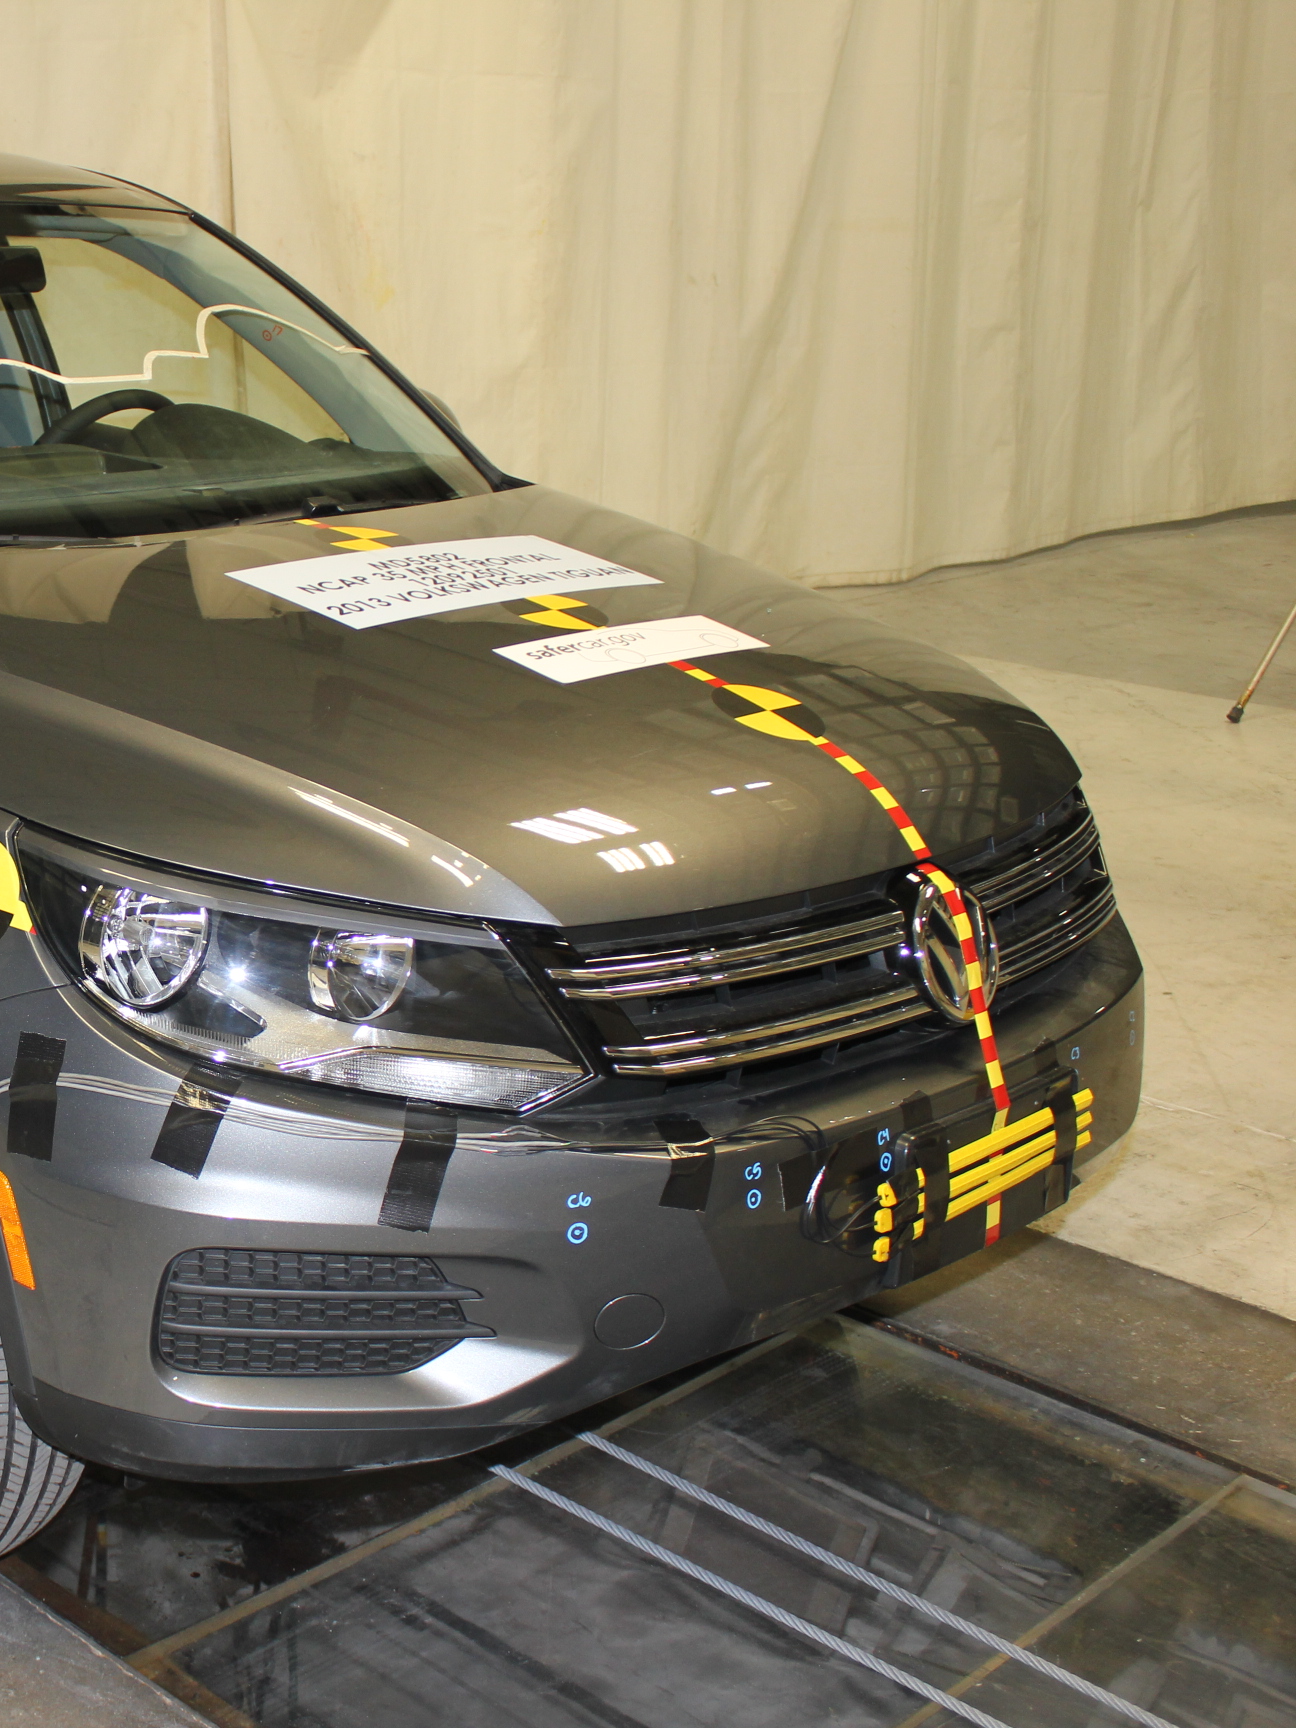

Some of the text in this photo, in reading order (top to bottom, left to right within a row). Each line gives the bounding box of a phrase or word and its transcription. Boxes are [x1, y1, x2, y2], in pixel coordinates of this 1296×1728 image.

[368, 552, 467, 571] MD5802
[296, 553, 561, 595] NCAP 35 MPH FRONTAL
[408, 566, 518, 587] 12092501
[326, 565, 635, 616] 2013 VOLKSWAGEN TIGUAN
[526, 632, 646, 660] safercar.gov
[877, 1127, 890, 1146] C4
[744, 1162, 763, 1181] C5
[567, 1191, 592, 1208] C6
